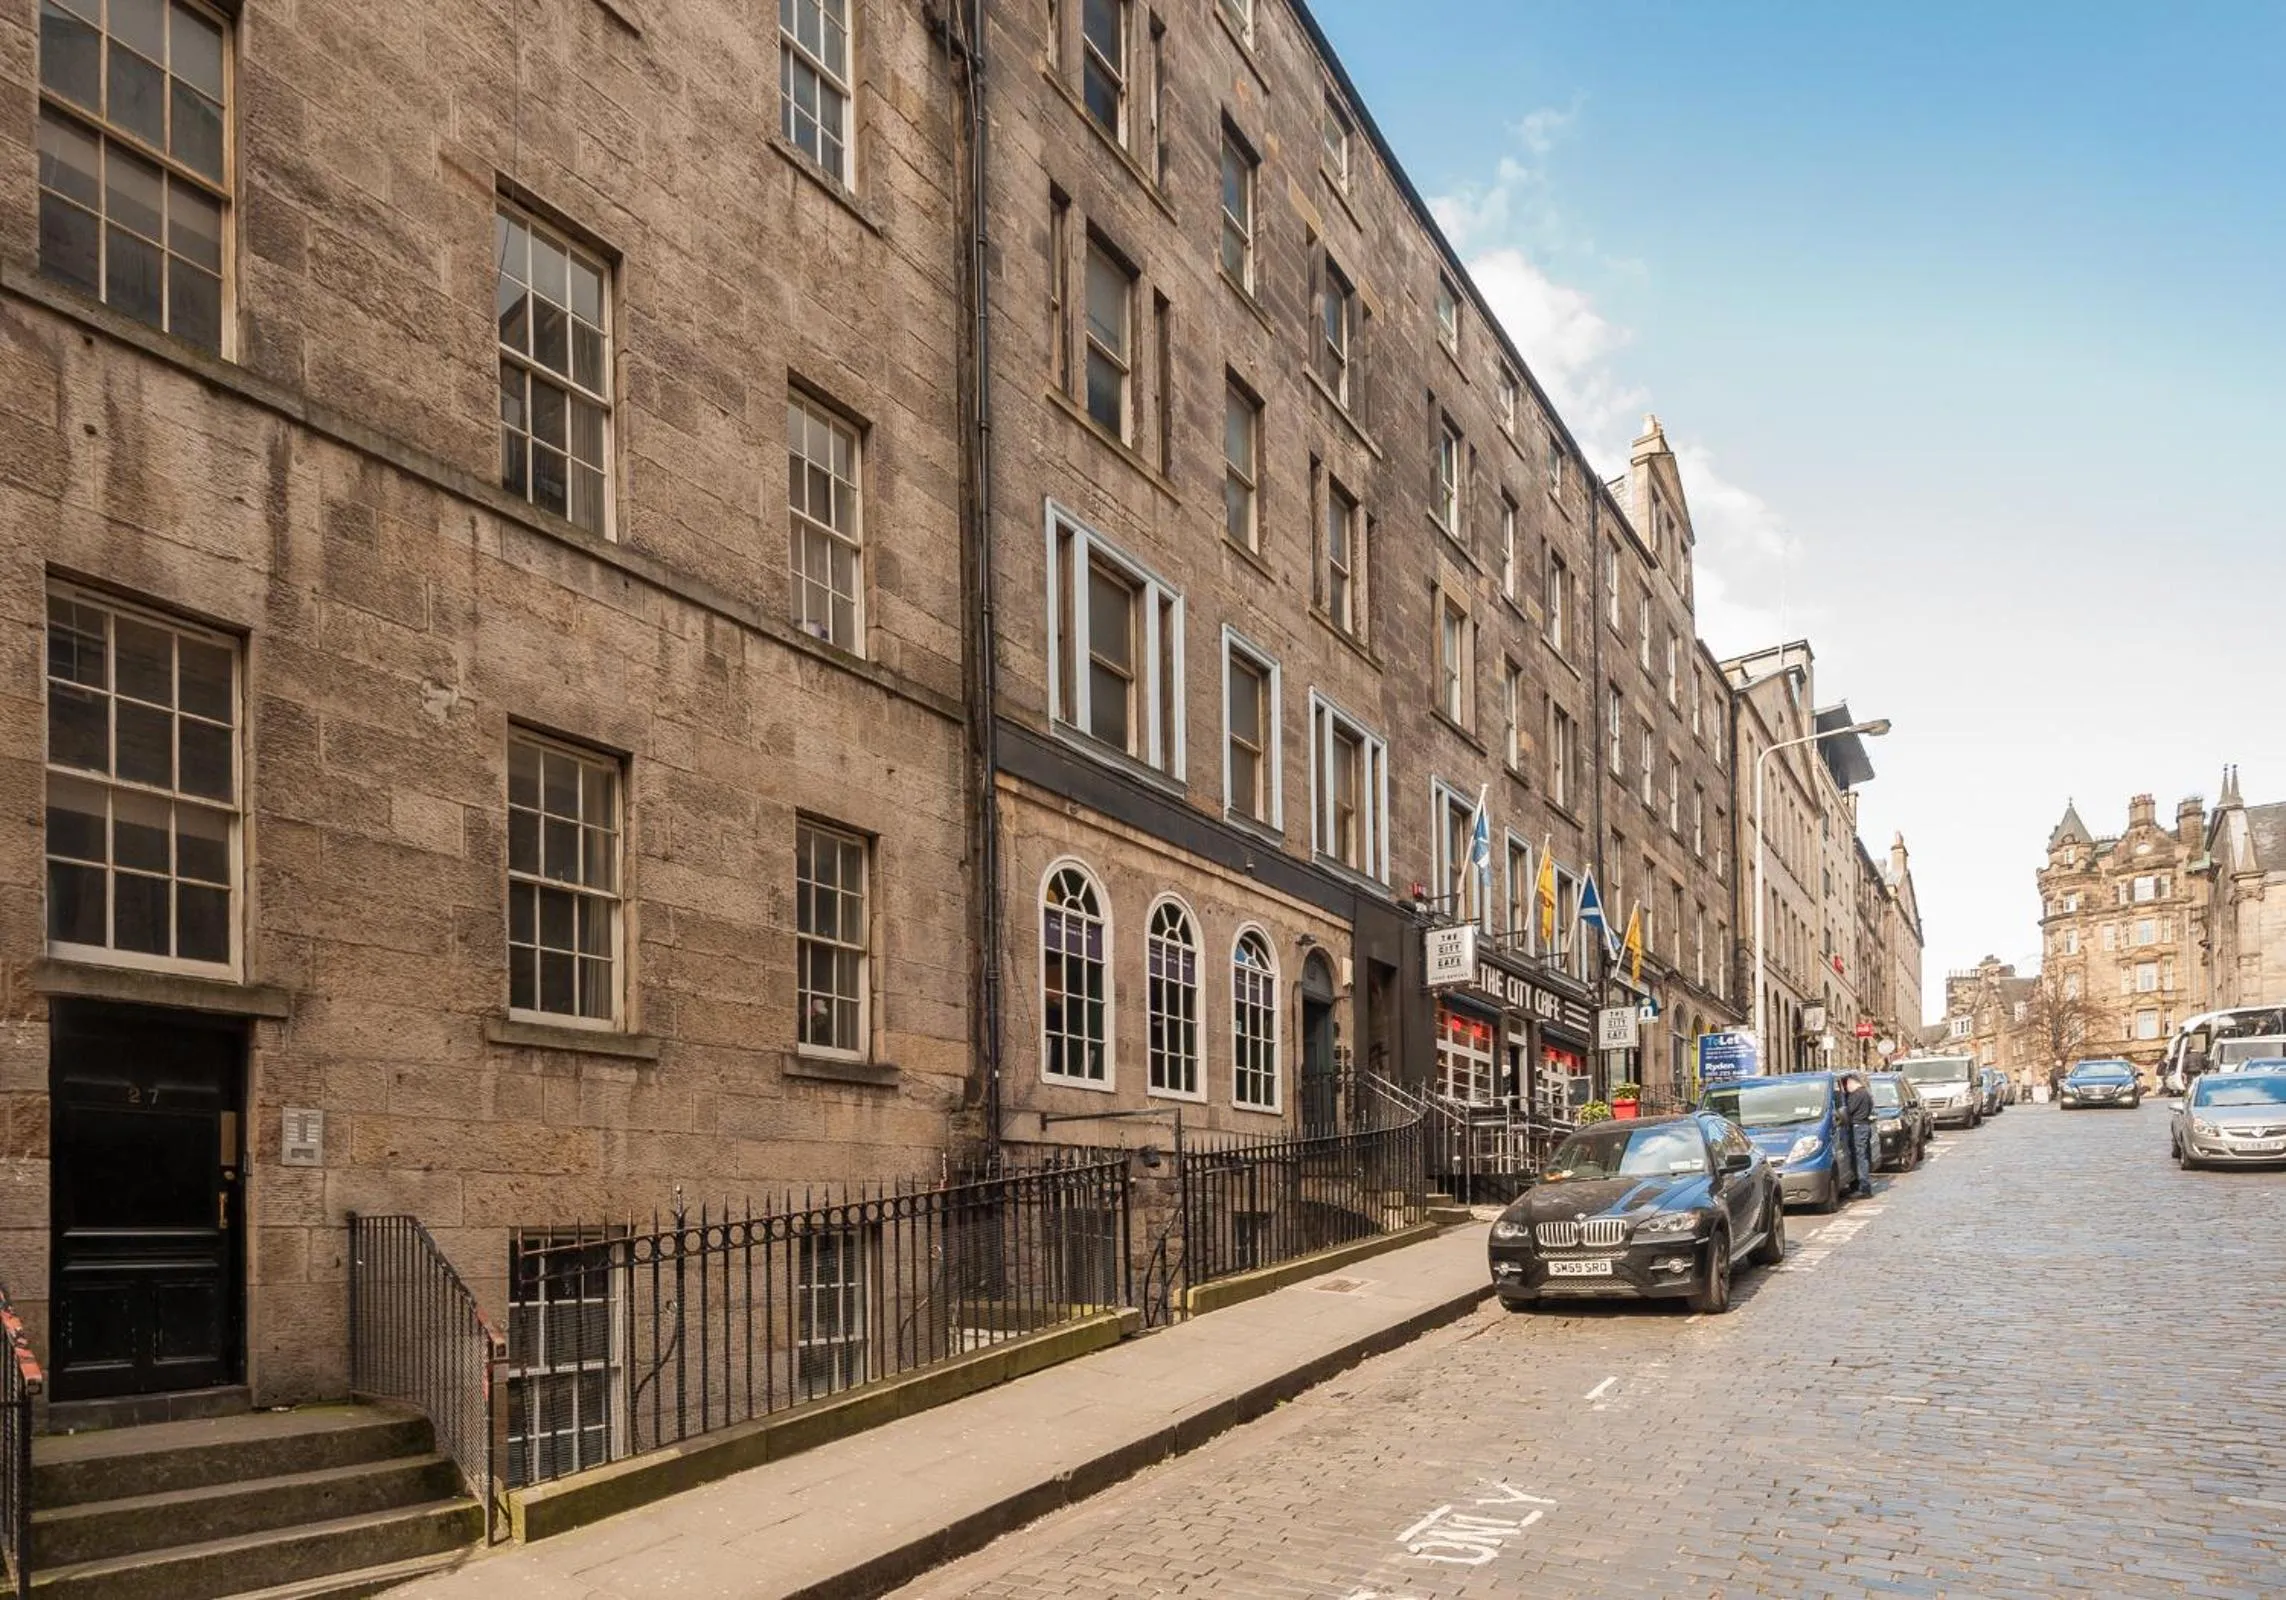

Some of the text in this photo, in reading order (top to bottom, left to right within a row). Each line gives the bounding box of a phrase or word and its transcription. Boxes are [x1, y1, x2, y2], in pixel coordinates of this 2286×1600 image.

[1440, 933, 1457, 941] THE
[1438, 944, 1460, 953] CITY
[1479, 962, 1560, 1021] THE CITY CAFE
[1609, 1010, 1624, 1018] THE
[1608, 1019, 1626, 1027] CITY
[1704, 1062, 1735, 1073] Ryden
[128, 1087, 159, 1104] 27
[1396, 1481, 1556, 1565] ONLY
